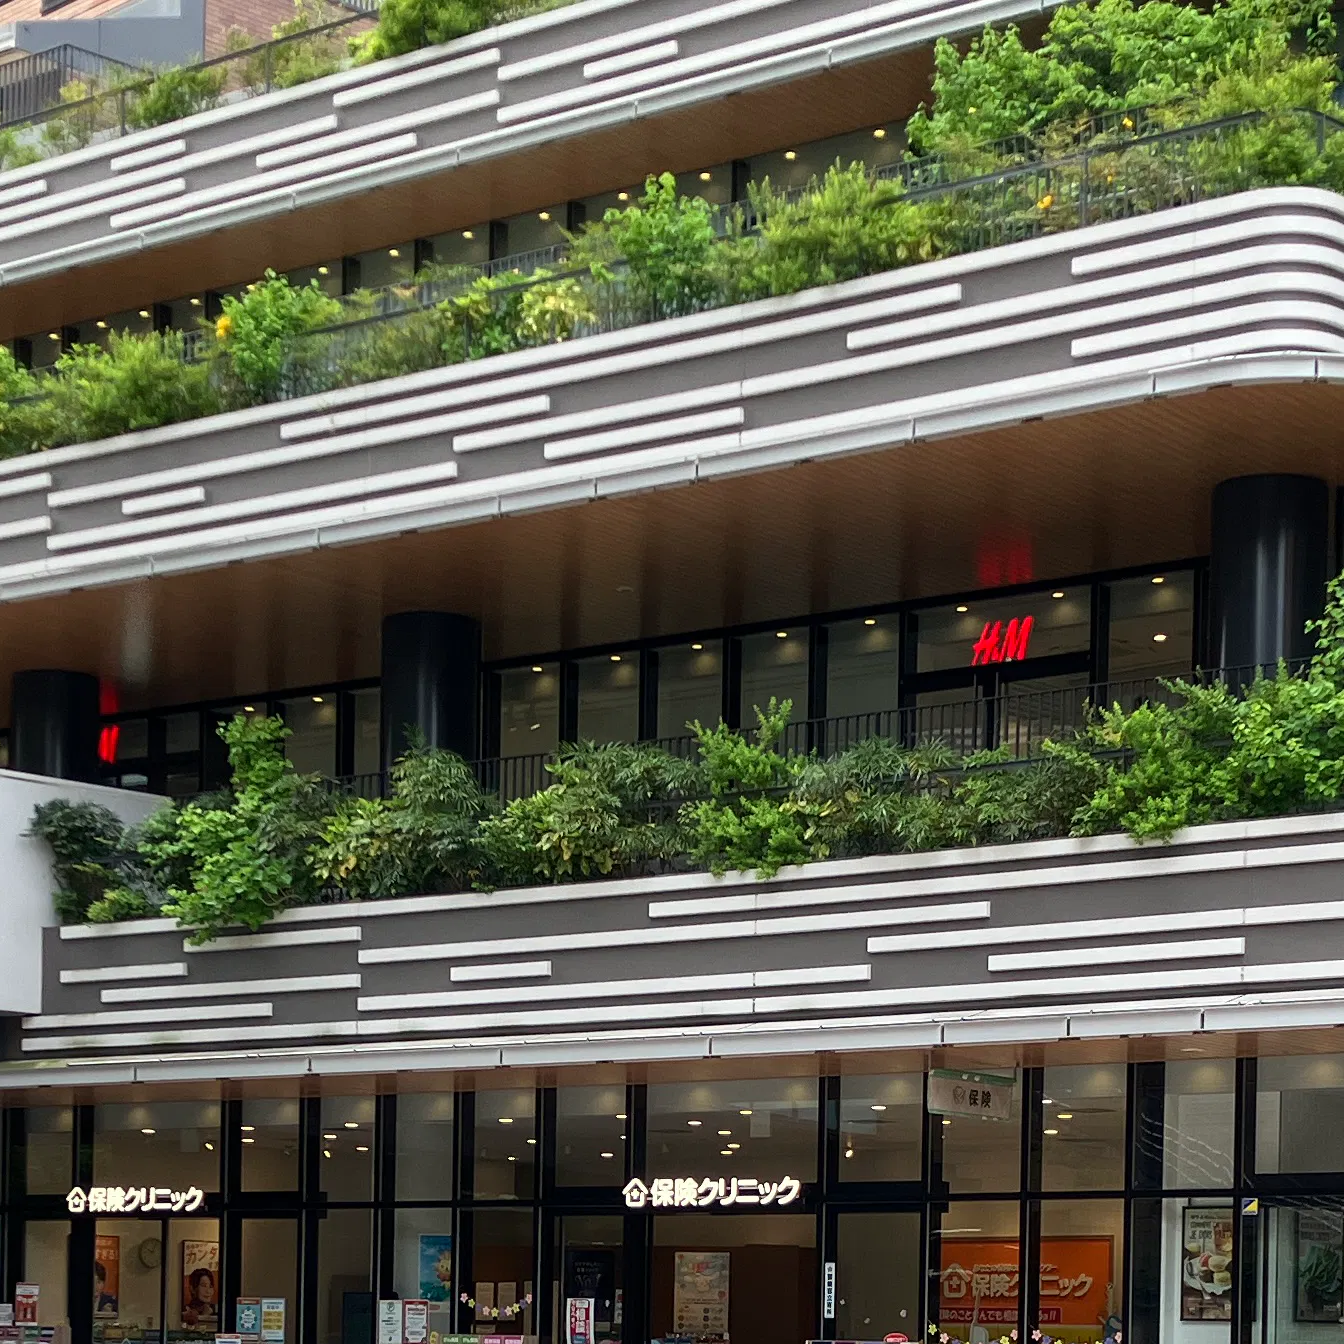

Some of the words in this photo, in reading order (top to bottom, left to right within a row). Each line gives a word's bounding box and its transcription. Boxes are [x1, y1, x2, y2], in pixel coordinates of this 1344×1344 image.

[971, 616, 1034, 665] H&M
[968, 1089, 992, 1108] 保険
[88, 1186, 204, 1212] 保険クリニック
[650, 1175, 801, 1207] 保険クリニック
